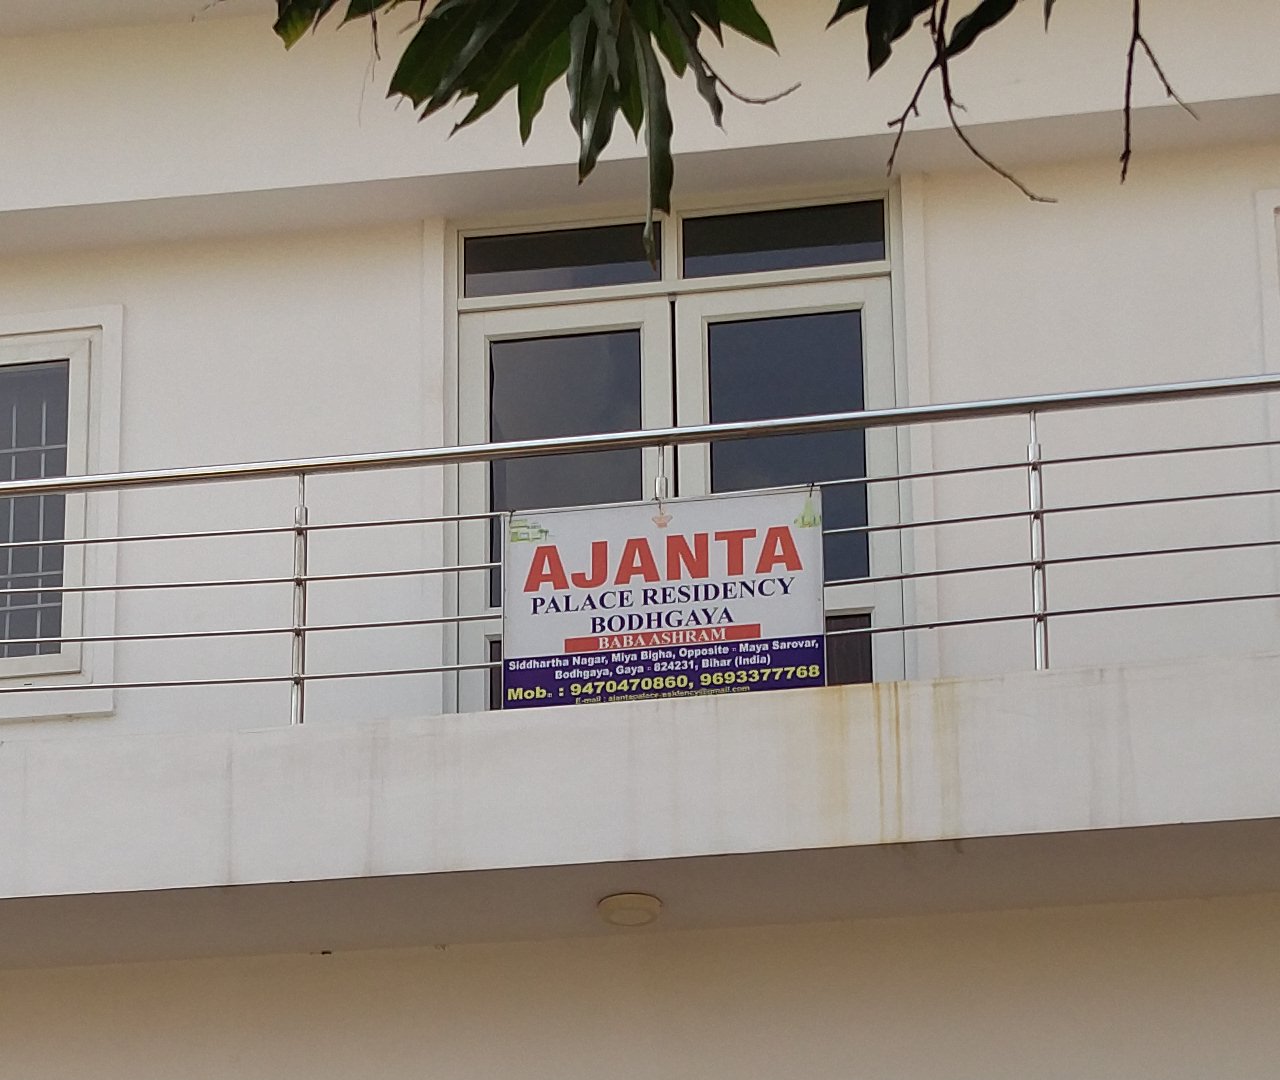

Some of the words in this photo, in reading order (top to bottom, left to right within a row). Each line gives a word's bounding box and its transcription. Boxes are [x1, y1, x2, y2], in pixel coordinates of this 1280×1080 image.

[523, 525, 803, 592] AJANTA
[530, 590, 634, 615] PALACE
[641, 577, 795, 606] RESIDENCY
[590, 606, 734, 634] BODHGAYA
[508, 657, 569, 671] Siddhartha
[572, 655, 608, 667] Nagar,
[611, 651, 637, 664] Miya
[640, 647, 676, 662] Bigha,
[678, 644, 729, 660] Opposite
[739, 642, 769, 655] Maya
[772, 638, 819, 650] Sarovar,
[599, 634, 645, 650] BABA
[648, 627, 726, 646] ASHRAM
[507, 686, 553, 700] Mob.
[570, 674, 694, 696] 9470470860,
[700, 664, 820, 687] 9693377768
[555, 666, 613, 680] Bodhgaya,
[616, 664, 644, 677] Gaya
[653, 659, 699, 673] 824231,
[701, 656, 731, 669] Bihar
[734, 653, 771, 668] (India)
